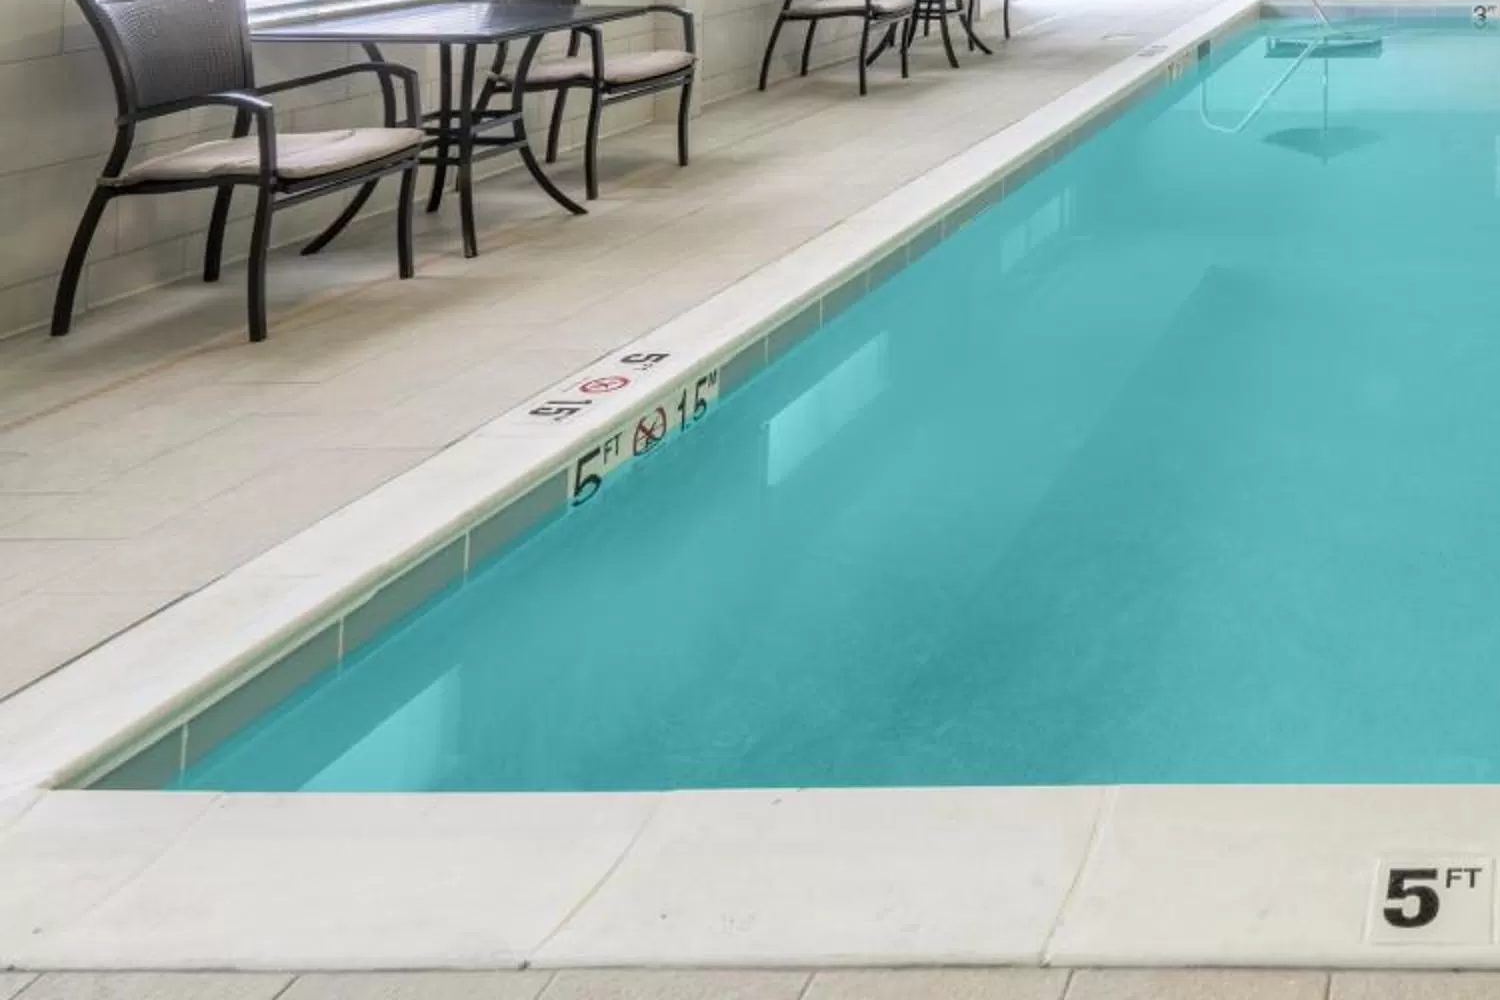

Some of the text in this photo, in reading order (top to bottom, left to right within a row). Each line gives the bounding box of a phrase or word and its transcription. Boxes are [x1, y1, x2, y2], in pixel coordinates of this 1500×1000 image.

[572, 447, 602, 507] 5
[603, 431, 623, 465] FT
[1382, 867, 1441, 929] 5
[1444, 867, 1483, 889] FT
